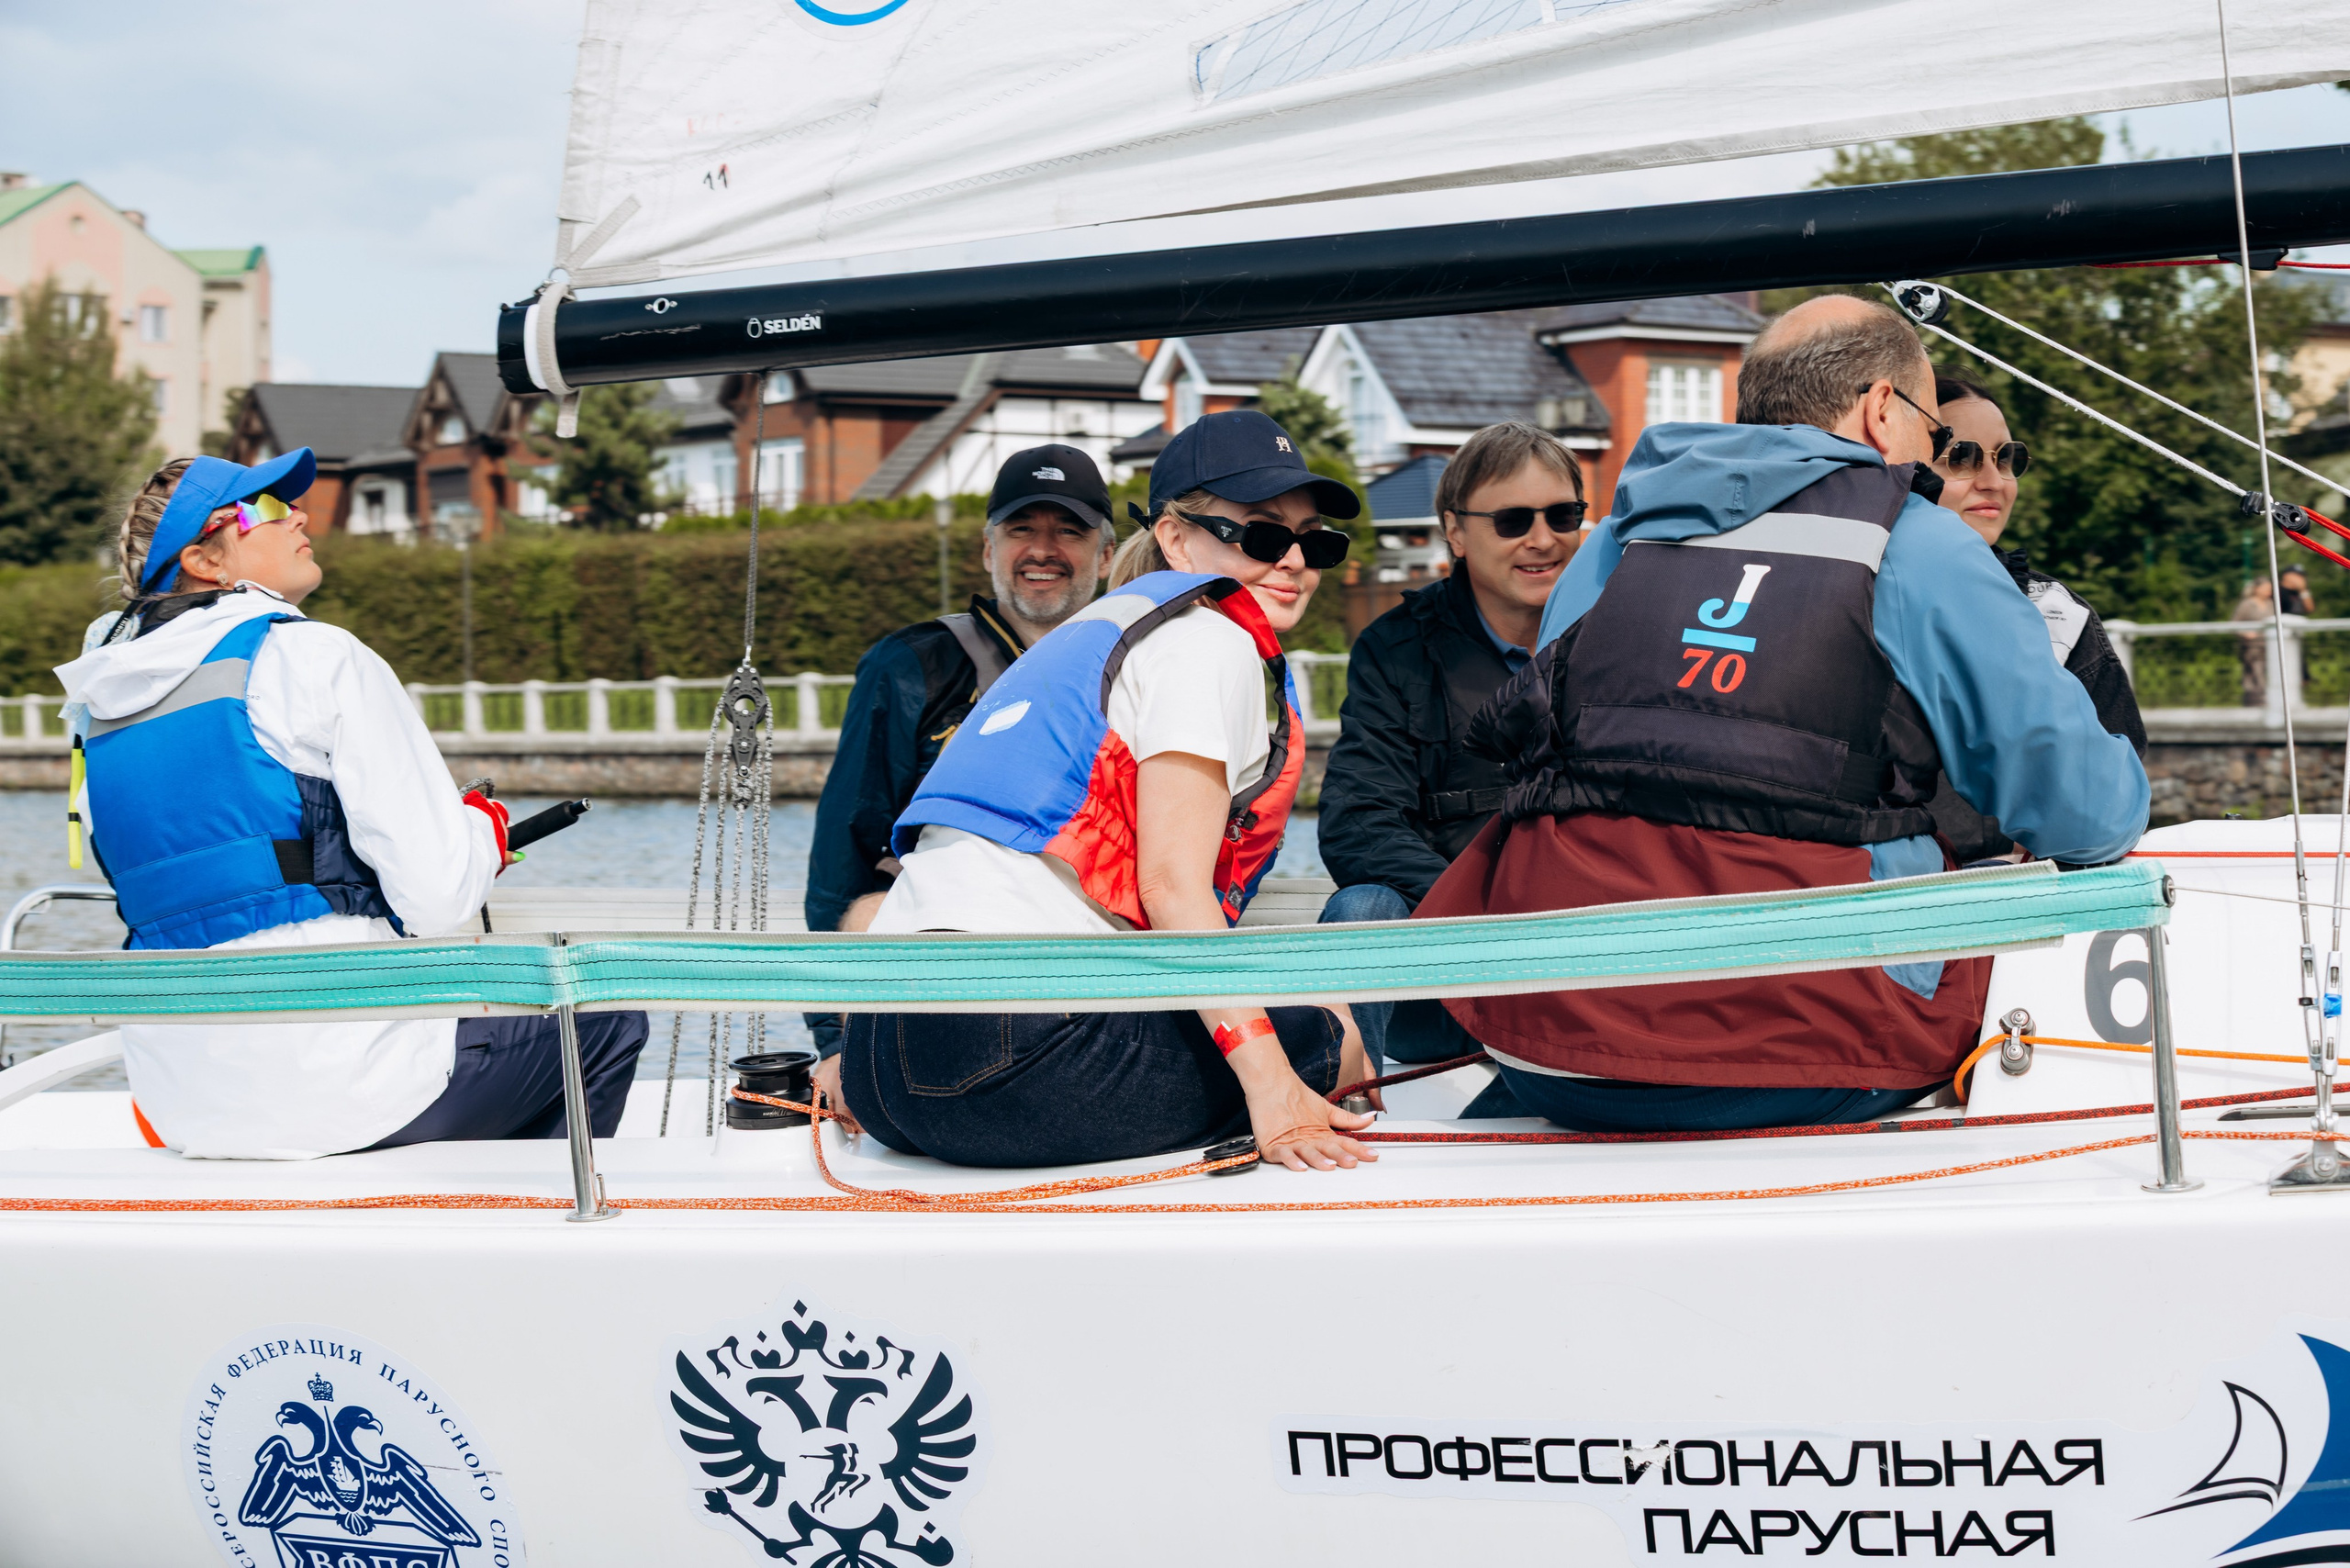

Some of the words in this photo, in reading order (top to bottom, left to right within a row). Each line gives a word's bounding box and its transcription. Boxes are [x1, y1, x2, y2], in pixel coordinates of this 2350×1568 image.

[763, 313, 822, 334] SELDÉN
[1697, 564, 1772, 629] J
[1676, 647, 1747, 694] 70
[2084, 927, 2170, 1045] 6
[193, 1383, 256, 1568] СЕРОССИЙСКАЯ
[227, 1338, 364, 1379] ФЕДЕРАЦИЯ
[378, 1362, 497, 1502] ПАРУСНОГО
[489, 1518, 510, 1568] СПО
[1287, 1430, 2106, 1487] ПРОФЕССИОНАЛЬНАЯ
[1643, 1507, 2056, 1557] ПАРУСНАЯ
